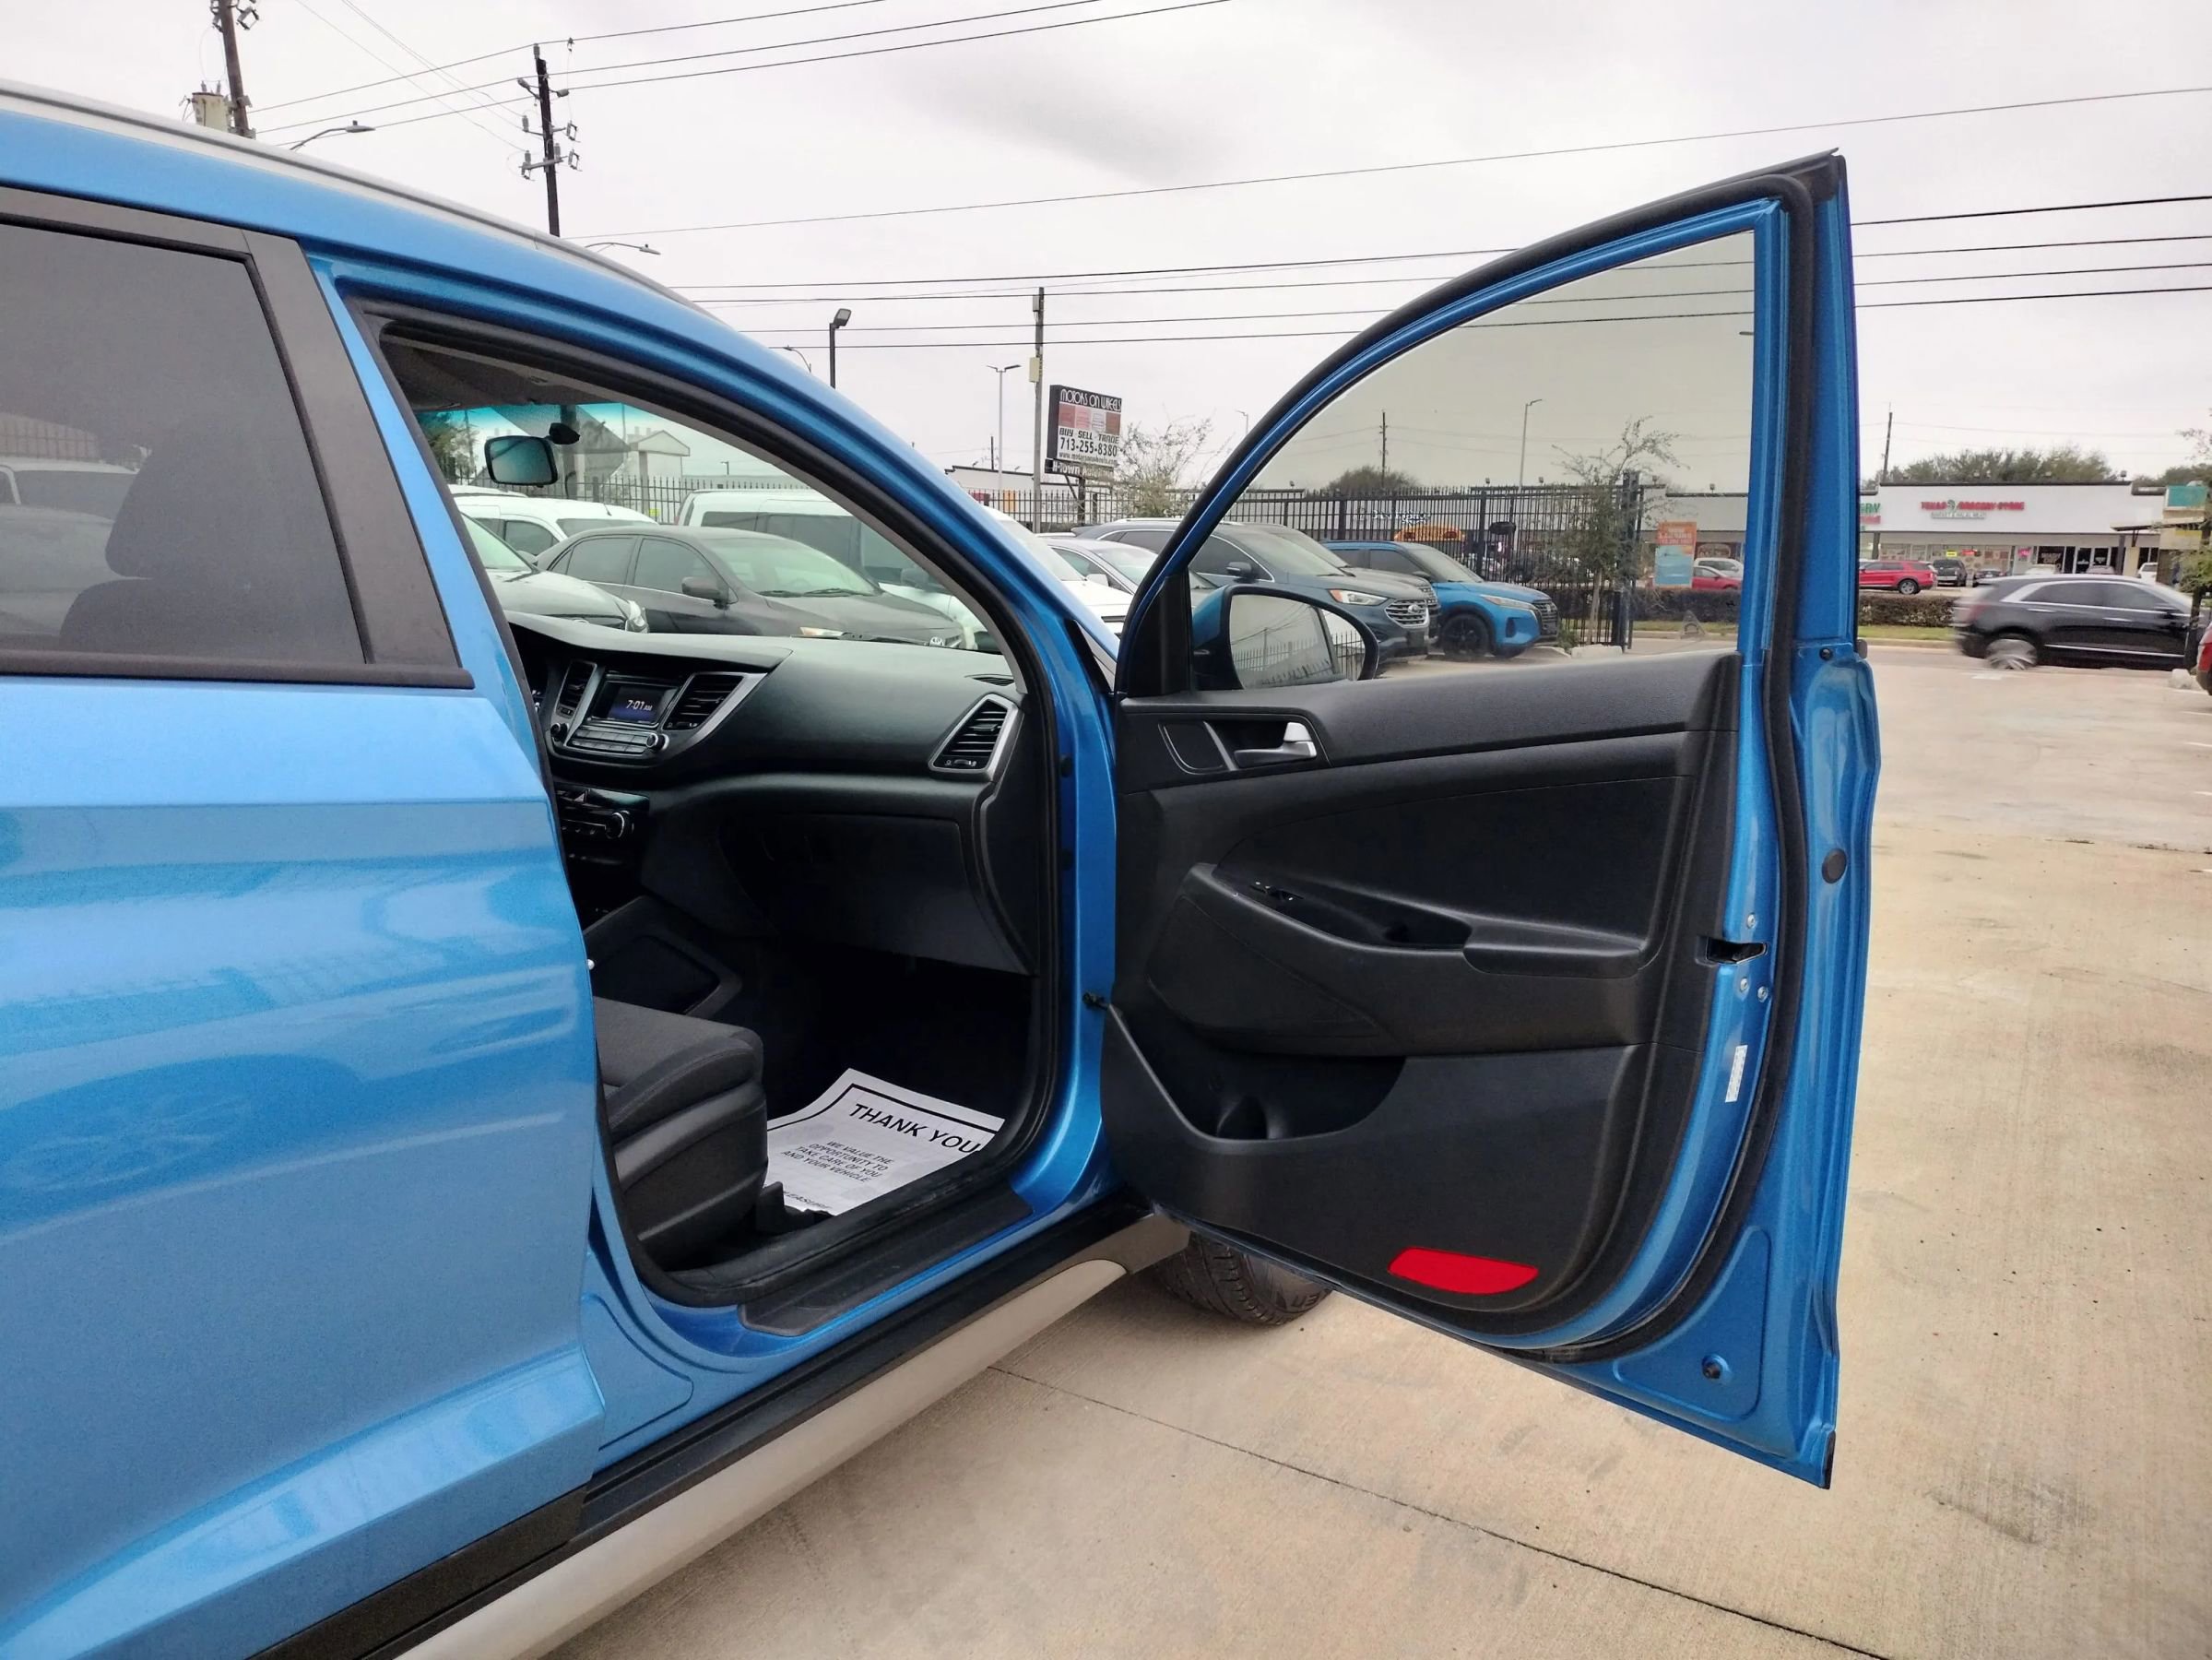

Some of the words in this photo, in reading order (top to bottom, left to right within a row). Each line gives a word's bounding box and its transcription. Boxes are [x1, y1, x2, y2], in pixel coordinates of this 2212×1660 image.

[1059, 427, 1073, 437] BUY
[1078, 431, 1093, 440] SELL
[1098, 433, 1119, 444] TRADE
[1060, 437, 1118, 457] 713-255-8380
[626, 699, 645, 710] 7:01
[849, 1103, 927, 1137] THANK
[929, 1130, 981, 1153] YOU
[796, 1146, 820, 1156] TAKE
[819, 1155, 846, 1166] CARE
[859, 1168, 882, 1178] YOU
[808, 1144, 871, 1167] OPPORTUNITY
[827, 1141, 844, 1149] WE
[843, 1146, 875, 1158] VALUE
[874, 1156, 894, 1165] THE
[781, 1151, 804, 1160] AND
[803, 1157, 831, 1169] YOUR
[829, 1166, 871, 1183] VEHICLE
